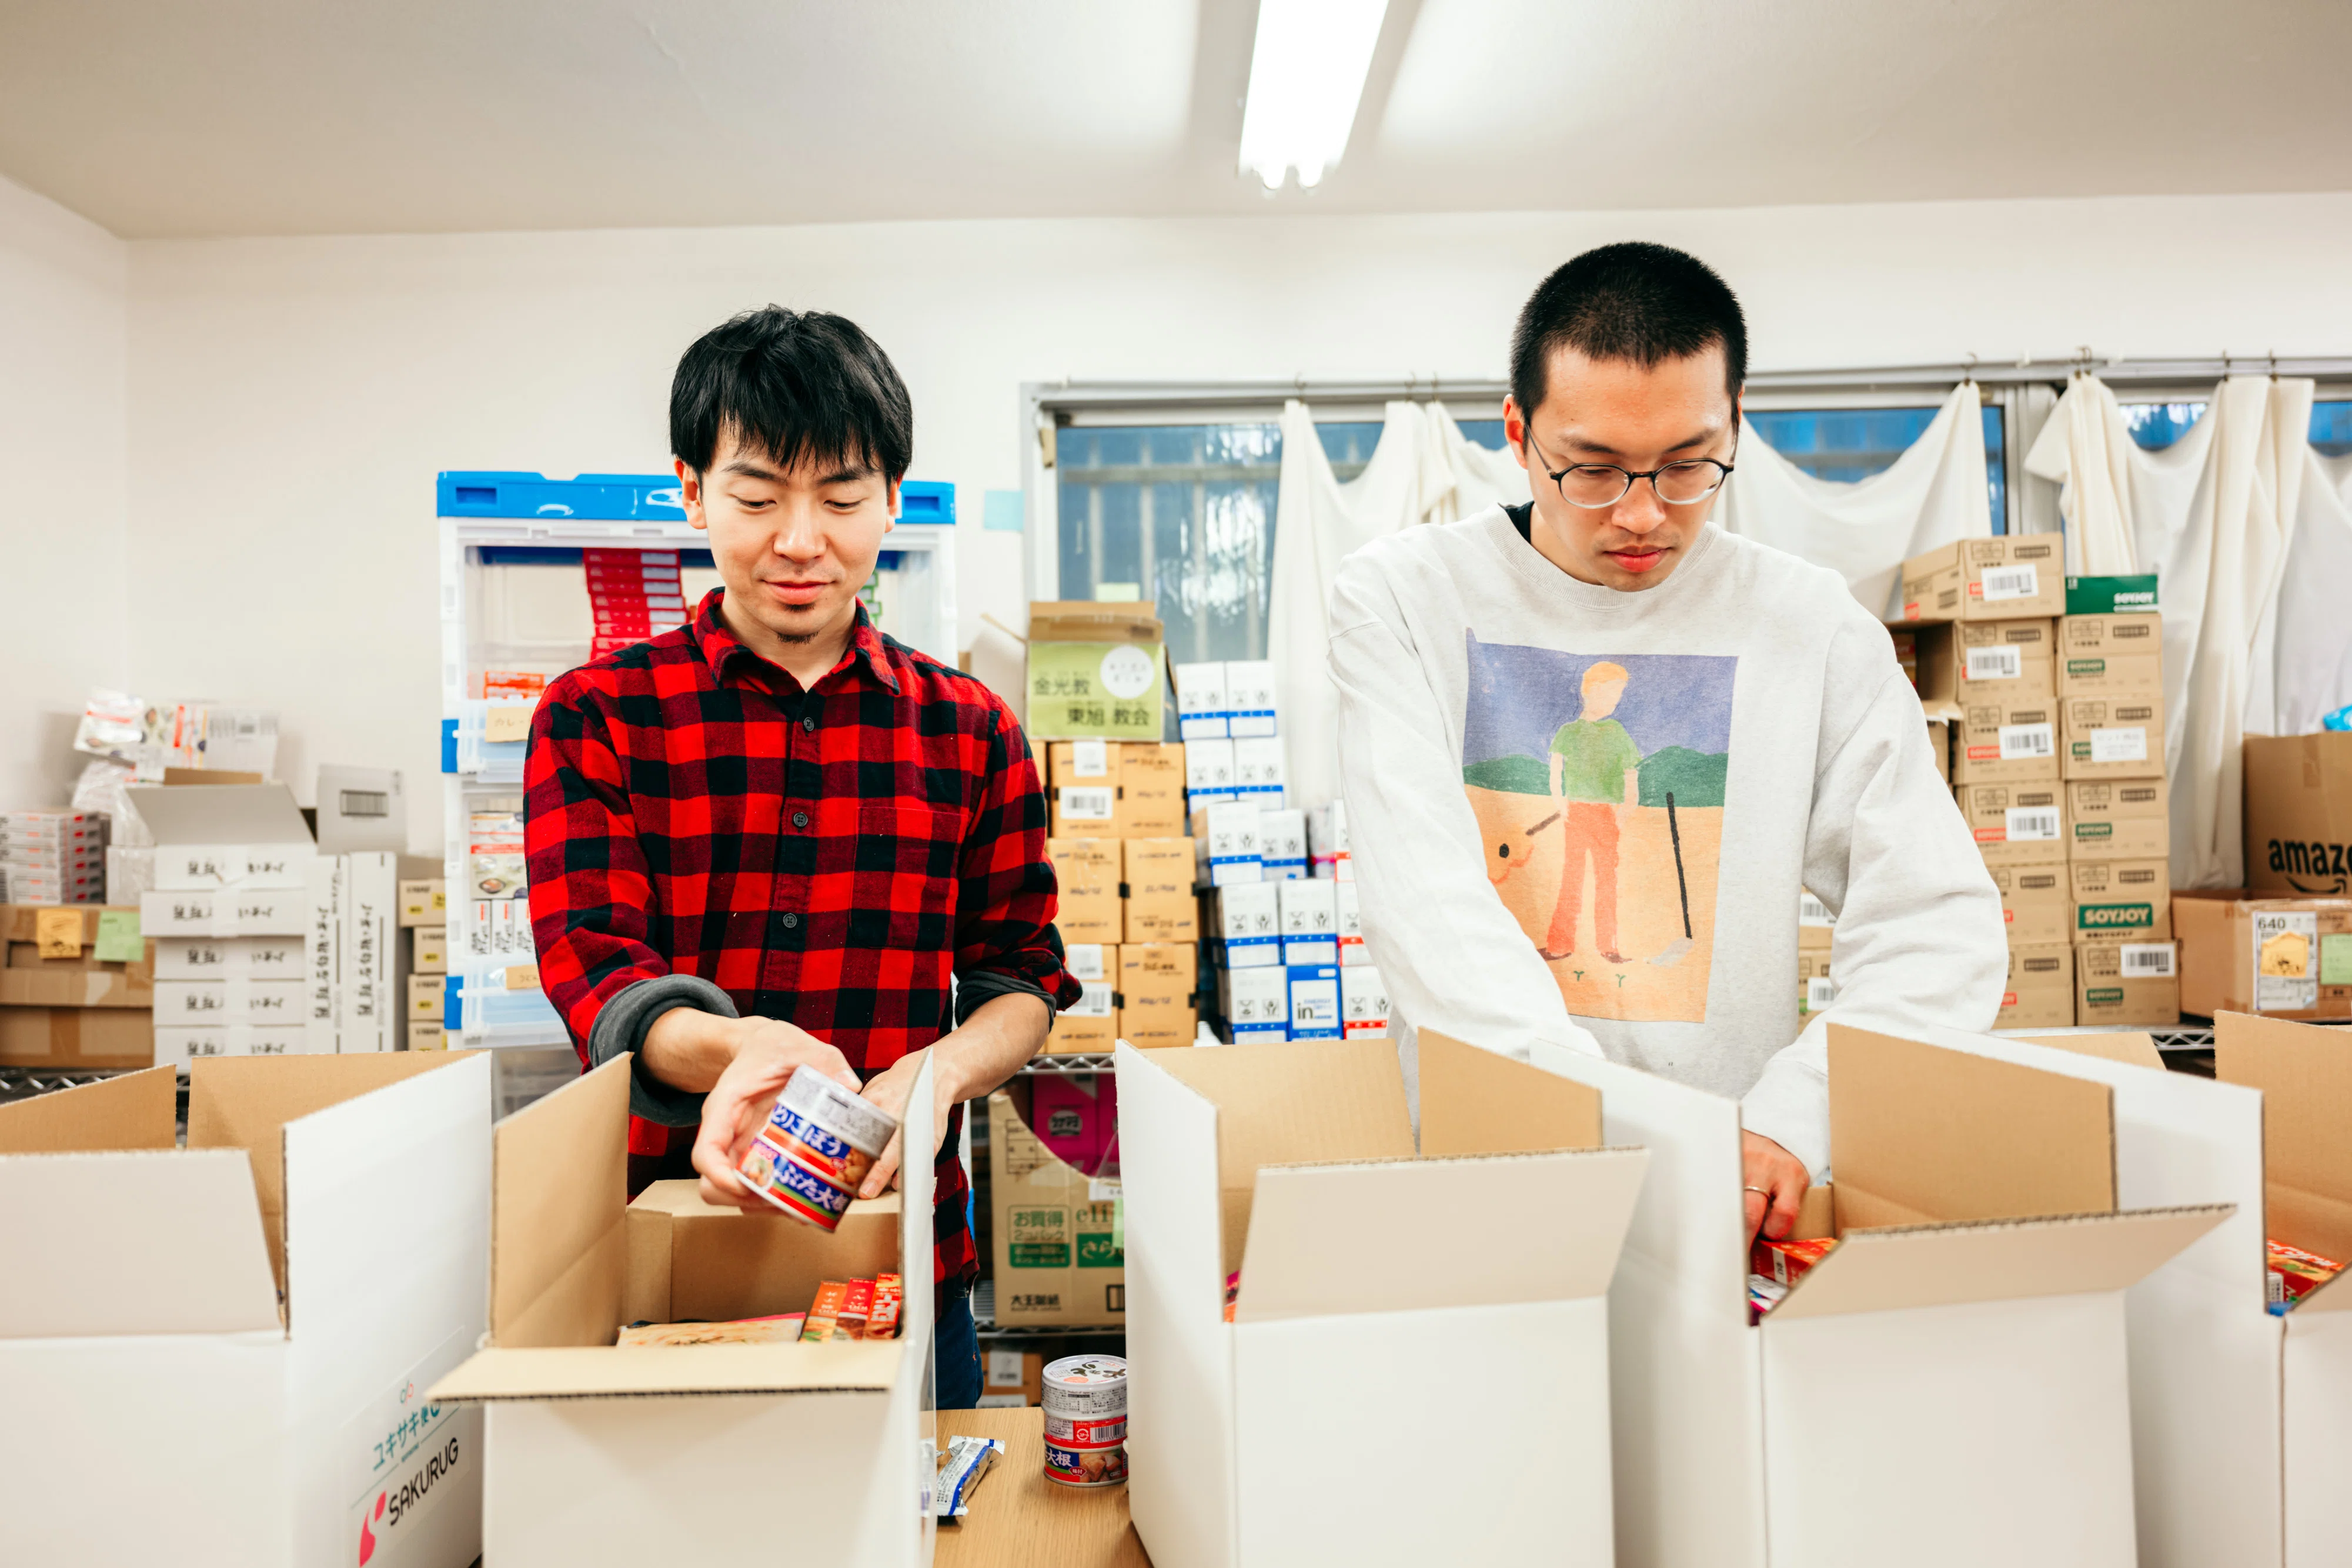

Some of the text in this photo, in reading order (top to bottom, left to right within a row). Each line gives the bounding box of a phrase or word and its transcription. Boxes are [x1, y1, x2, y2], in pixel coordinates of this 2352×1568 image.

[2084, 907, 2150, 925] SOYJOY
[2258, 917, 2286, 931] 640
[1297, 1002, 1313, 1020] in
[389, 1437, 459, 1526] SAKURUG
